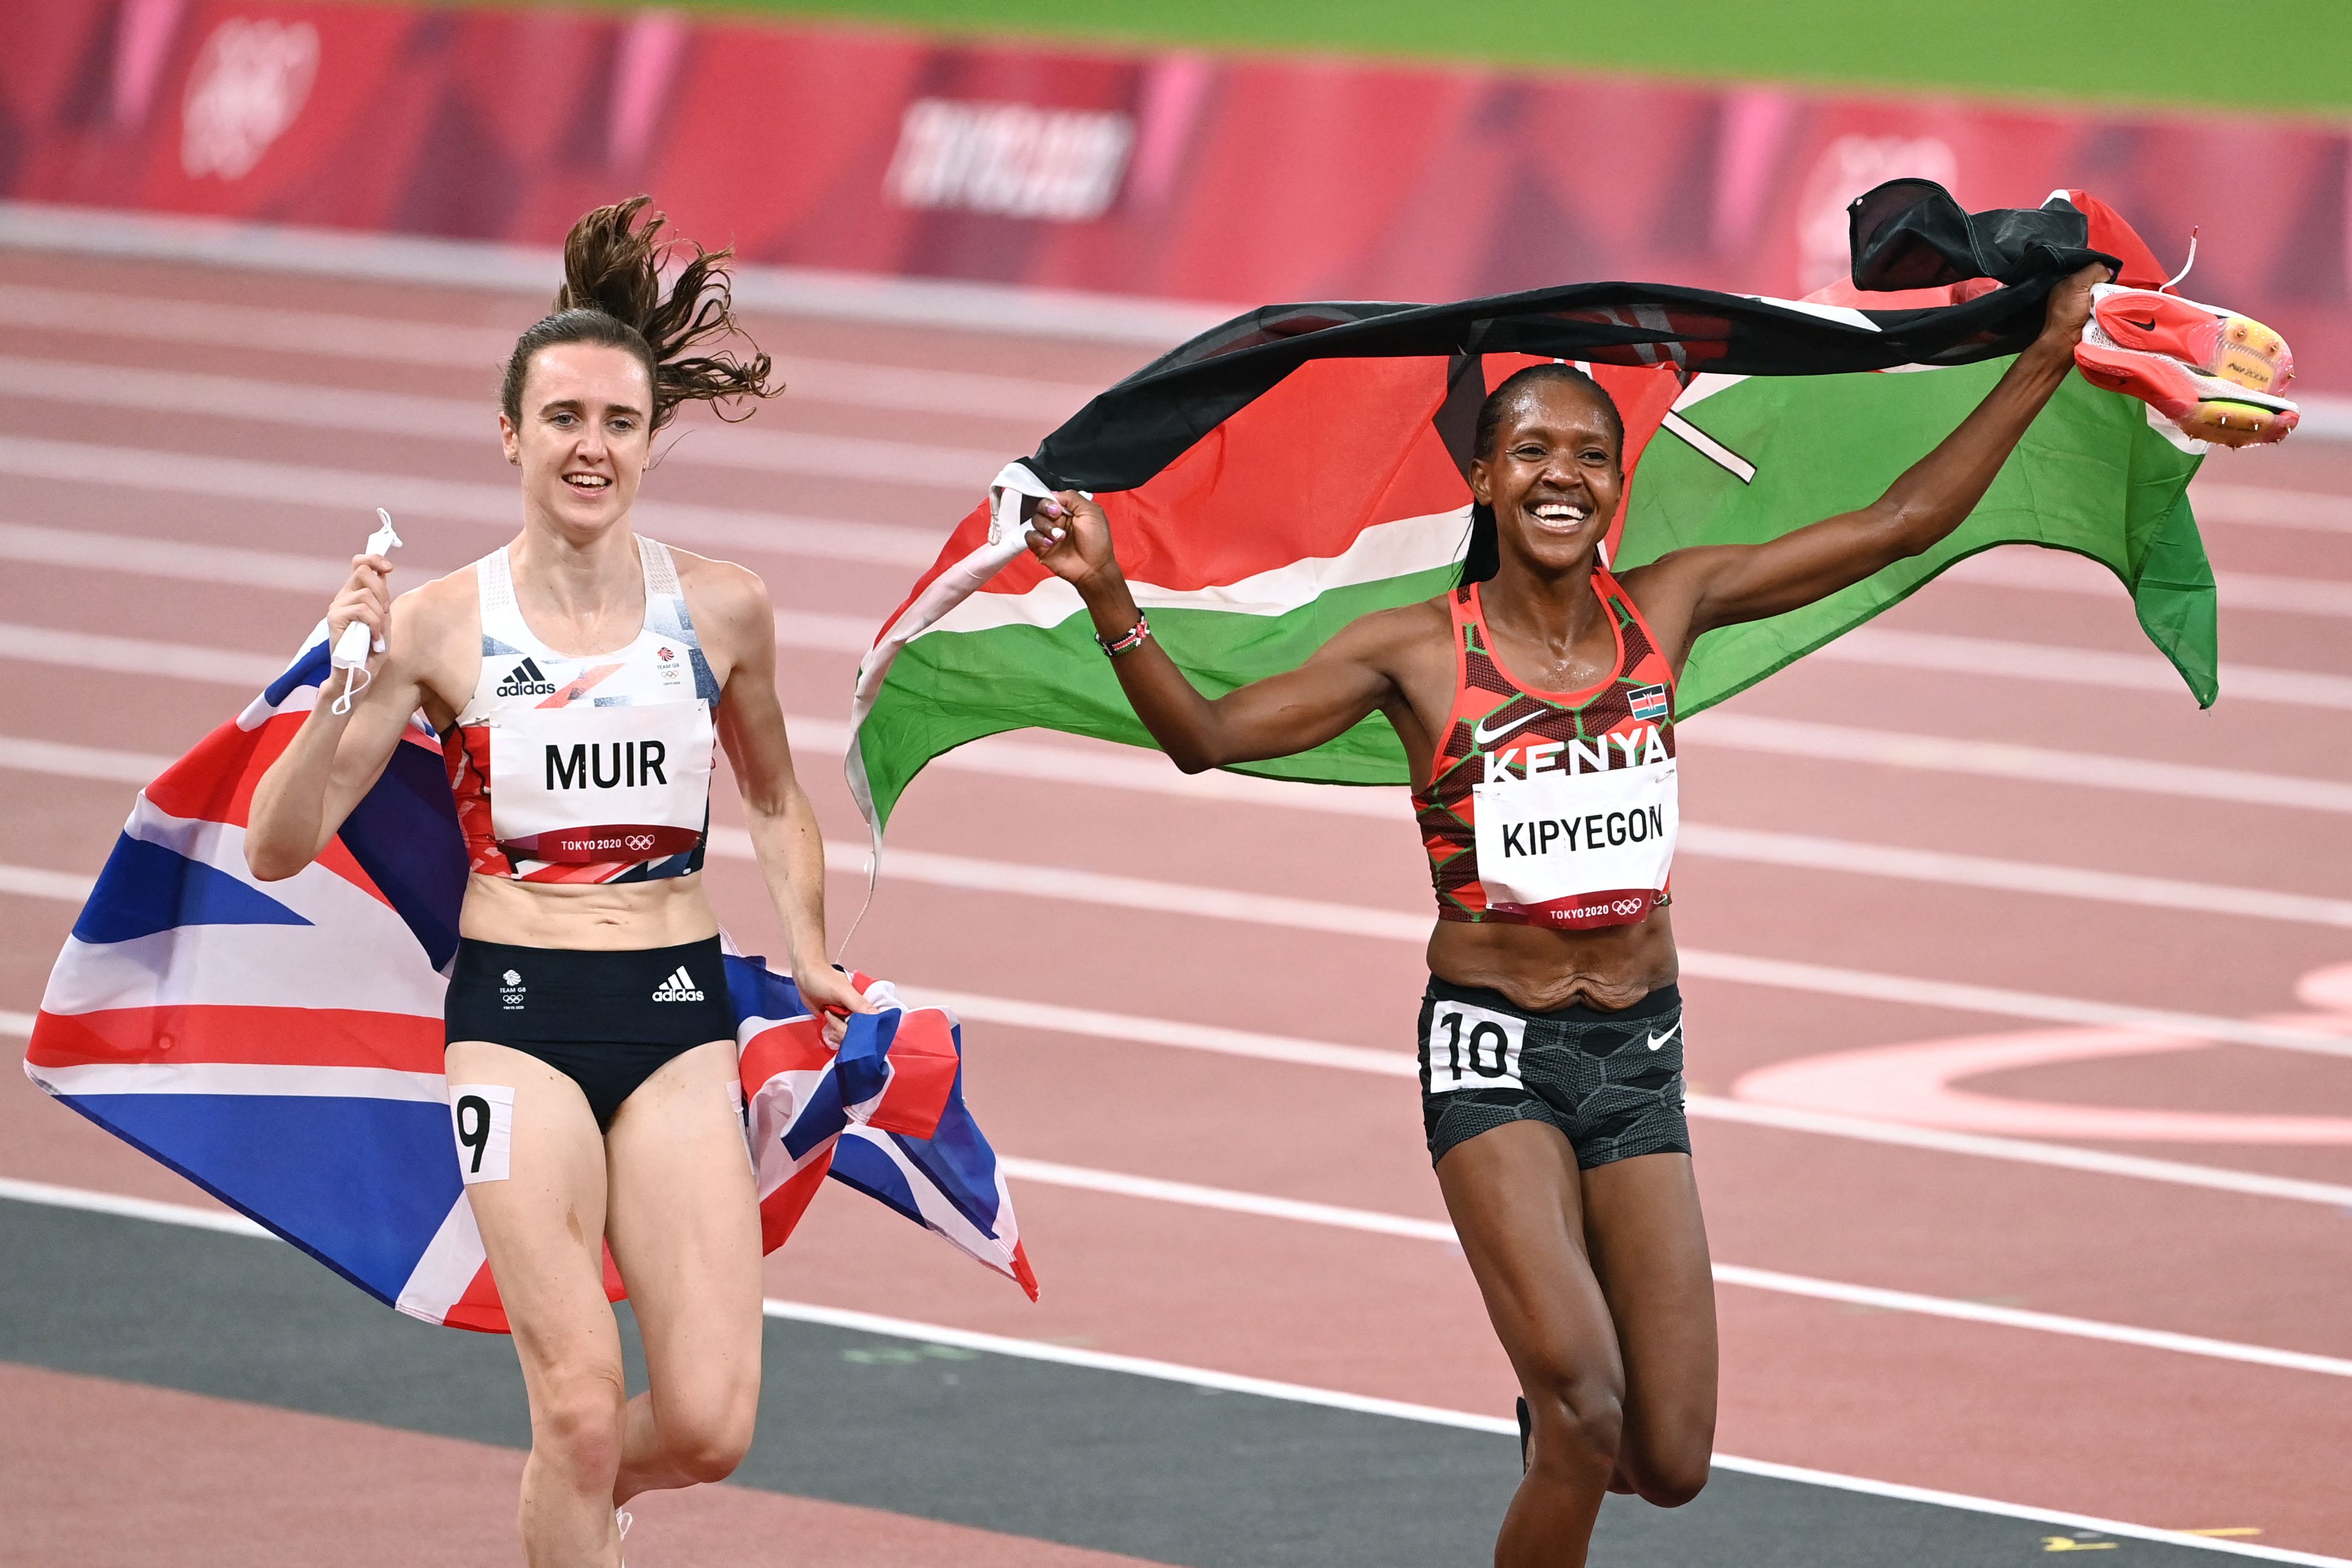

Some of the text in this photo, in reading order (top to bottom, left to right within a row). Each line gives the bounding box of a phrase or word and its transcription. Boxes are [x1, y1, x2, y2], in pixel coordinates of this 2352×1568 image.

[496, 682, 556, 697] adidas
[546, 740, 667, 790] MUIR
[1484, 725, 1669, 784] KENYA
[561, 839, 621, 851] TOKYO 2020
[1502, 804, 1663, 857] KIPYEGON
[1550, 905, 1609, 920] TOKYO 2020
[652, 988, 705, 1002] adidas
[1440, 1012, 1508, 1081] 10
[457, 1095, 490, 1173] 9
